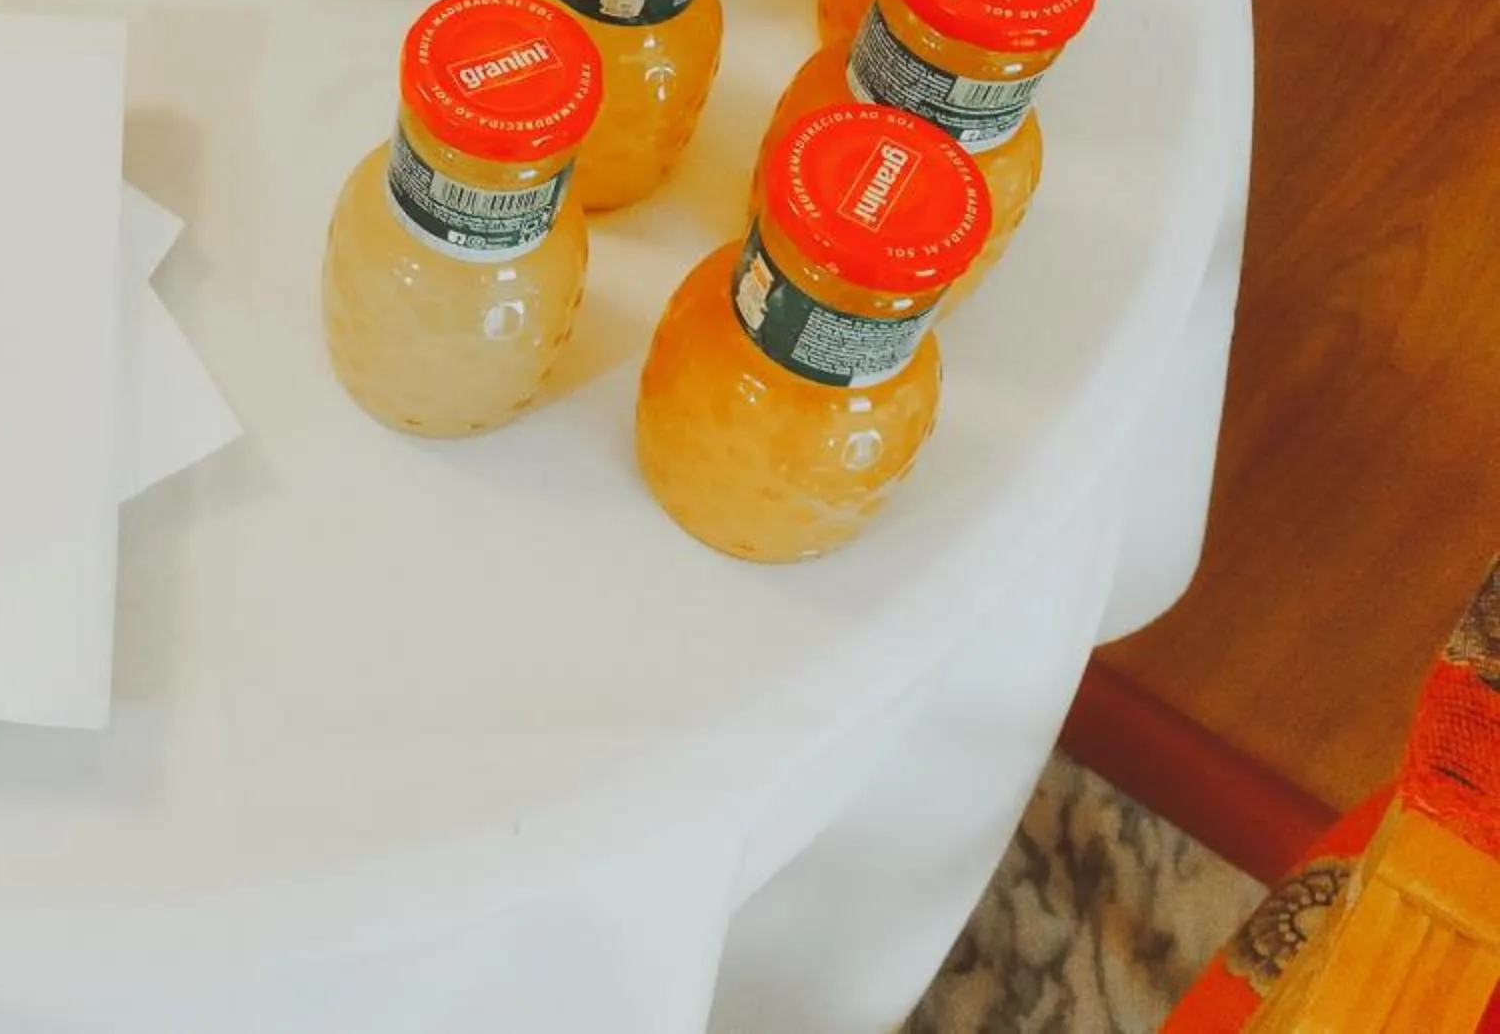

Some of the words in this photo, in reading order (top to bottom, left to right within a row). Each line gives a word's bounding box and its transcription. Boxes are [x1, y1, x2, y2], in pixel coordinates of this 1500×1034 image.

[459, 41, 549, 89] granini
[790, 111, 853, 174] AMADURECIDA
[859, 111, 879, 120] AO
[887, 115, 915, 130] SOL
[853, 145, 908, 224] granini
[943, 188, 978, 248] MADURADA
[885, 247, 915, 258] SOL
